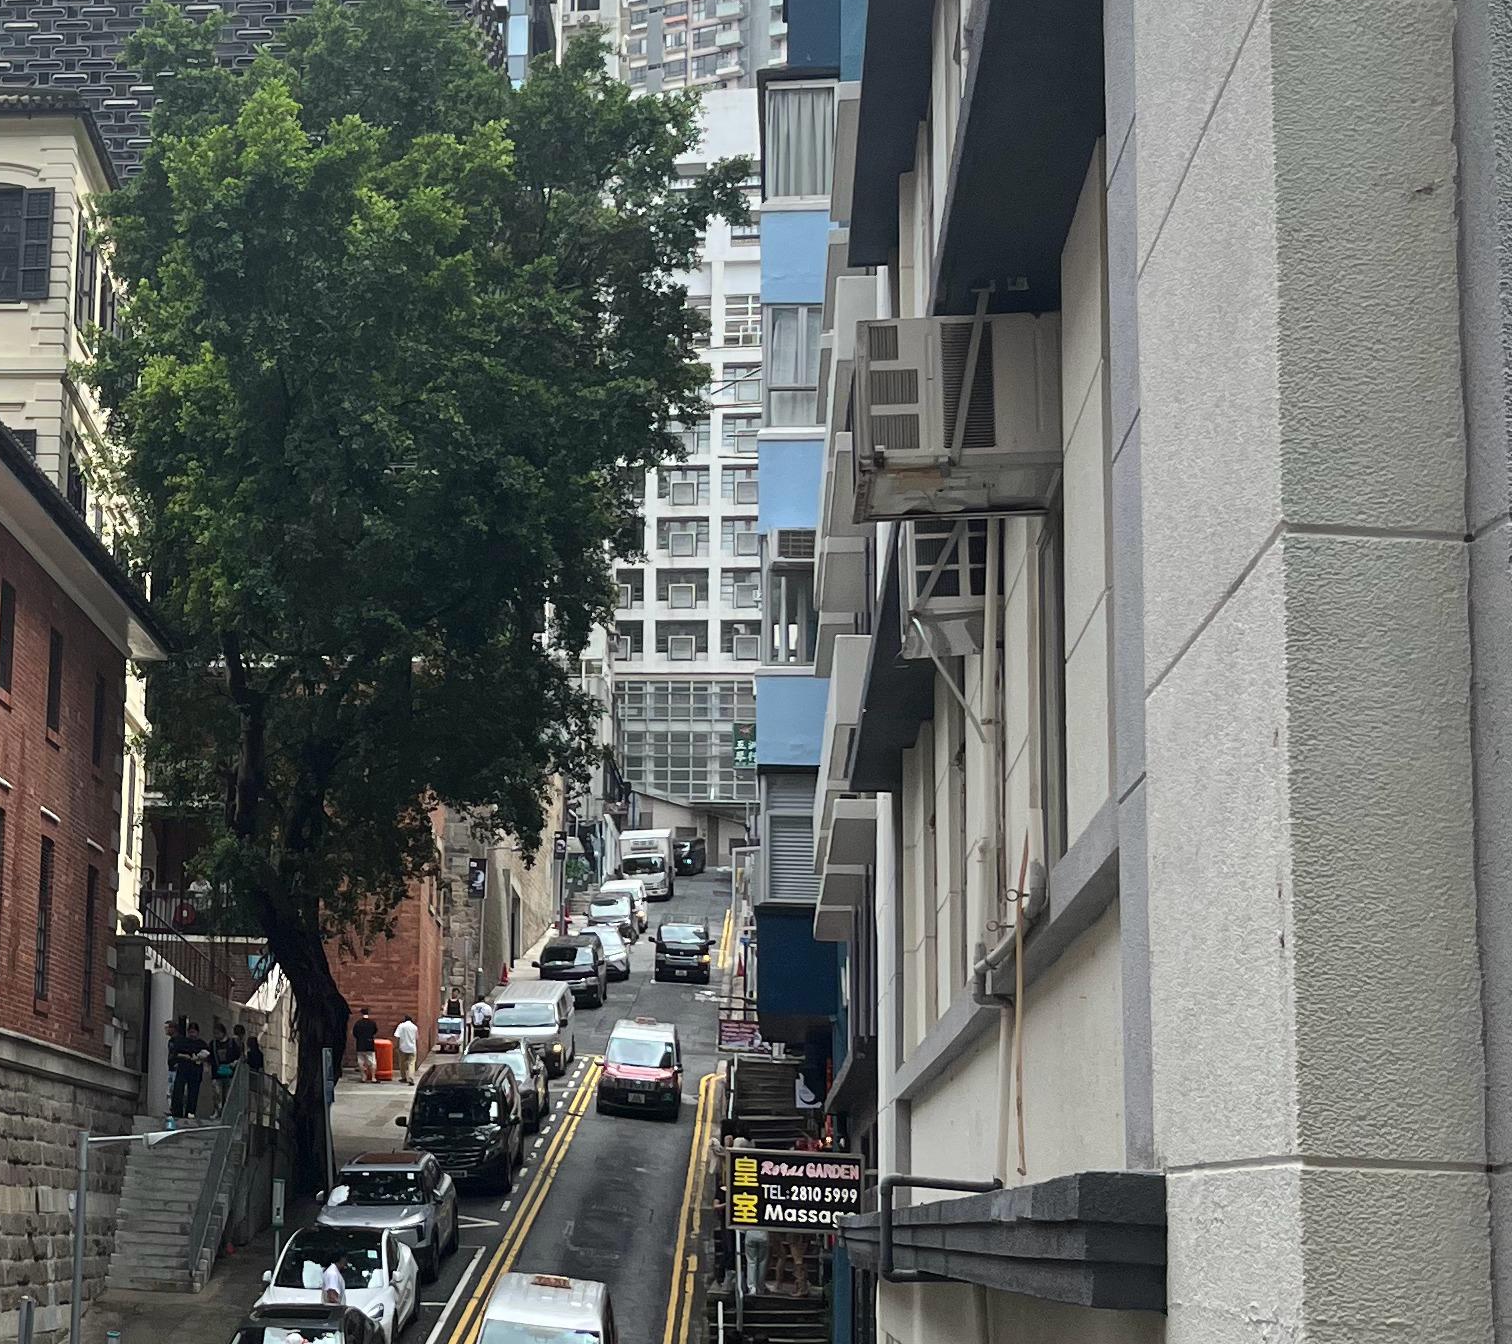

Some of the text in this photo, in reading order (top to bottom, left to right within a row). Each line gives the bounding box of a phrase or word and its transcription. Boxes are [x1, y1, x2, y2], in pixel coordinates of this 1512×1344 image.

[805, 1162, 860, 1180] GARDEN
[733, 1156, 759, 1223] 皇室
[824, 1188, 858, 1203] 5999
